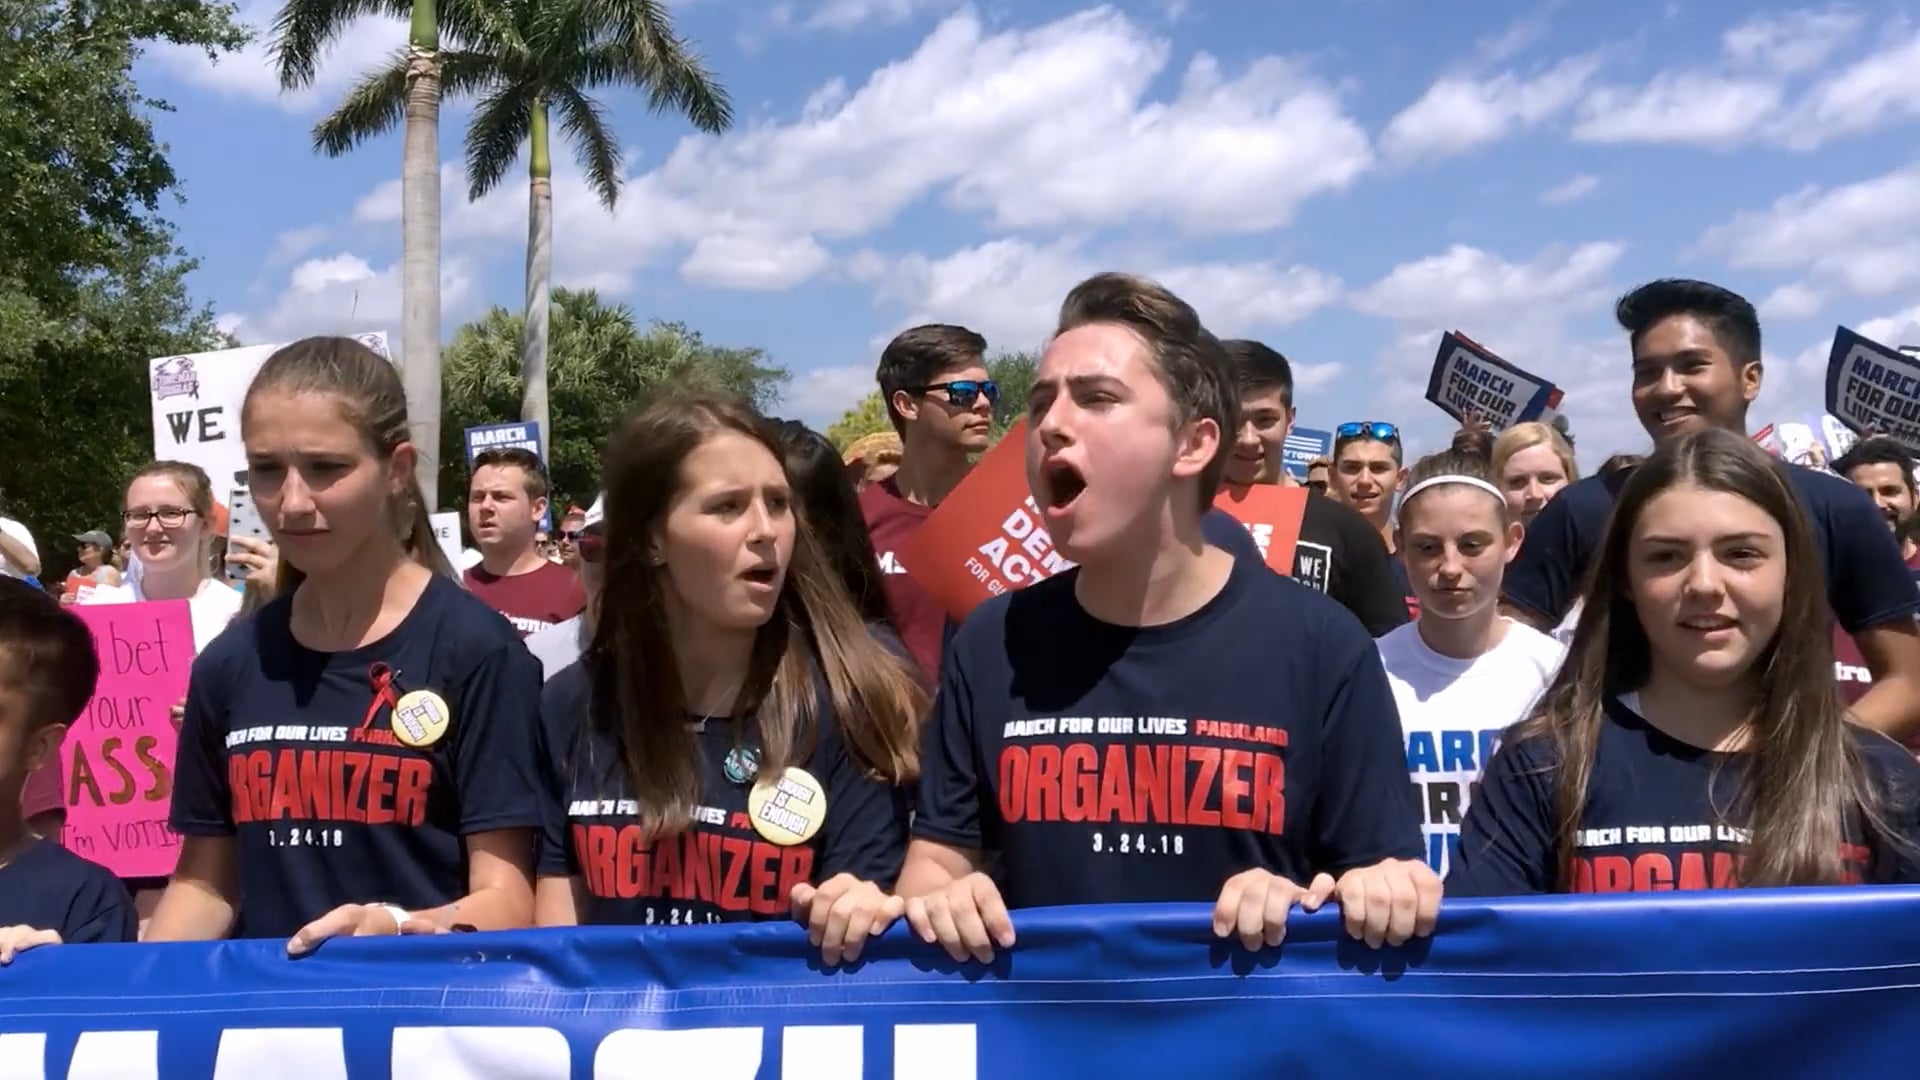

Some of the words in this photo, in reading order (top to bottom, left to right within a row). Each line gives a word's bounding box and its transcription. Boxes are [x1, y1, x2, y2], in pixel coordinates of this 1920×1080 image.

[1449, 371, 1479, 399] FOR
[1477, 389, 1517, 417] OUR
[1454, 356, 1514, 397] MARCH
[1846, 376, 1885, 409] FOR
[1884, 395, 1920, 425] OU
[166, 406, 226, 445] WE
[471, 426, 527, 447] MARCH
[964, 556, 989, 583] FOR
[1300, 554, 1323, 579] WE
[109, 618, 169, 676] bet
[247, 725, 274, 742] FOR
[274, 725, 309, 741] OUR
[309, 726, 349, 742] LIVES
[1003, 718, 1055, 738] MARCH
[1059, 717, 1094, 734] FOR
[1098, 717, 1134, 734] OUR
[1138, 717, 1188, 735] LIVES
[1195, 719, 1289, 747] PARKLAND
[69, 735, 171, 807] ASS
[228, 749, 433, 828] RGANIZER
[999, 742, 1286, 836] ORGANIZER
[101, 819, 179, 852] VOTI
[759, 802, 810, 837] ENOUGH
[1626, 825, 1666, 844] FOR
[1669, 824, 1712, 843] OUR
[1093, 833, 1185, 854] 3.24.18
